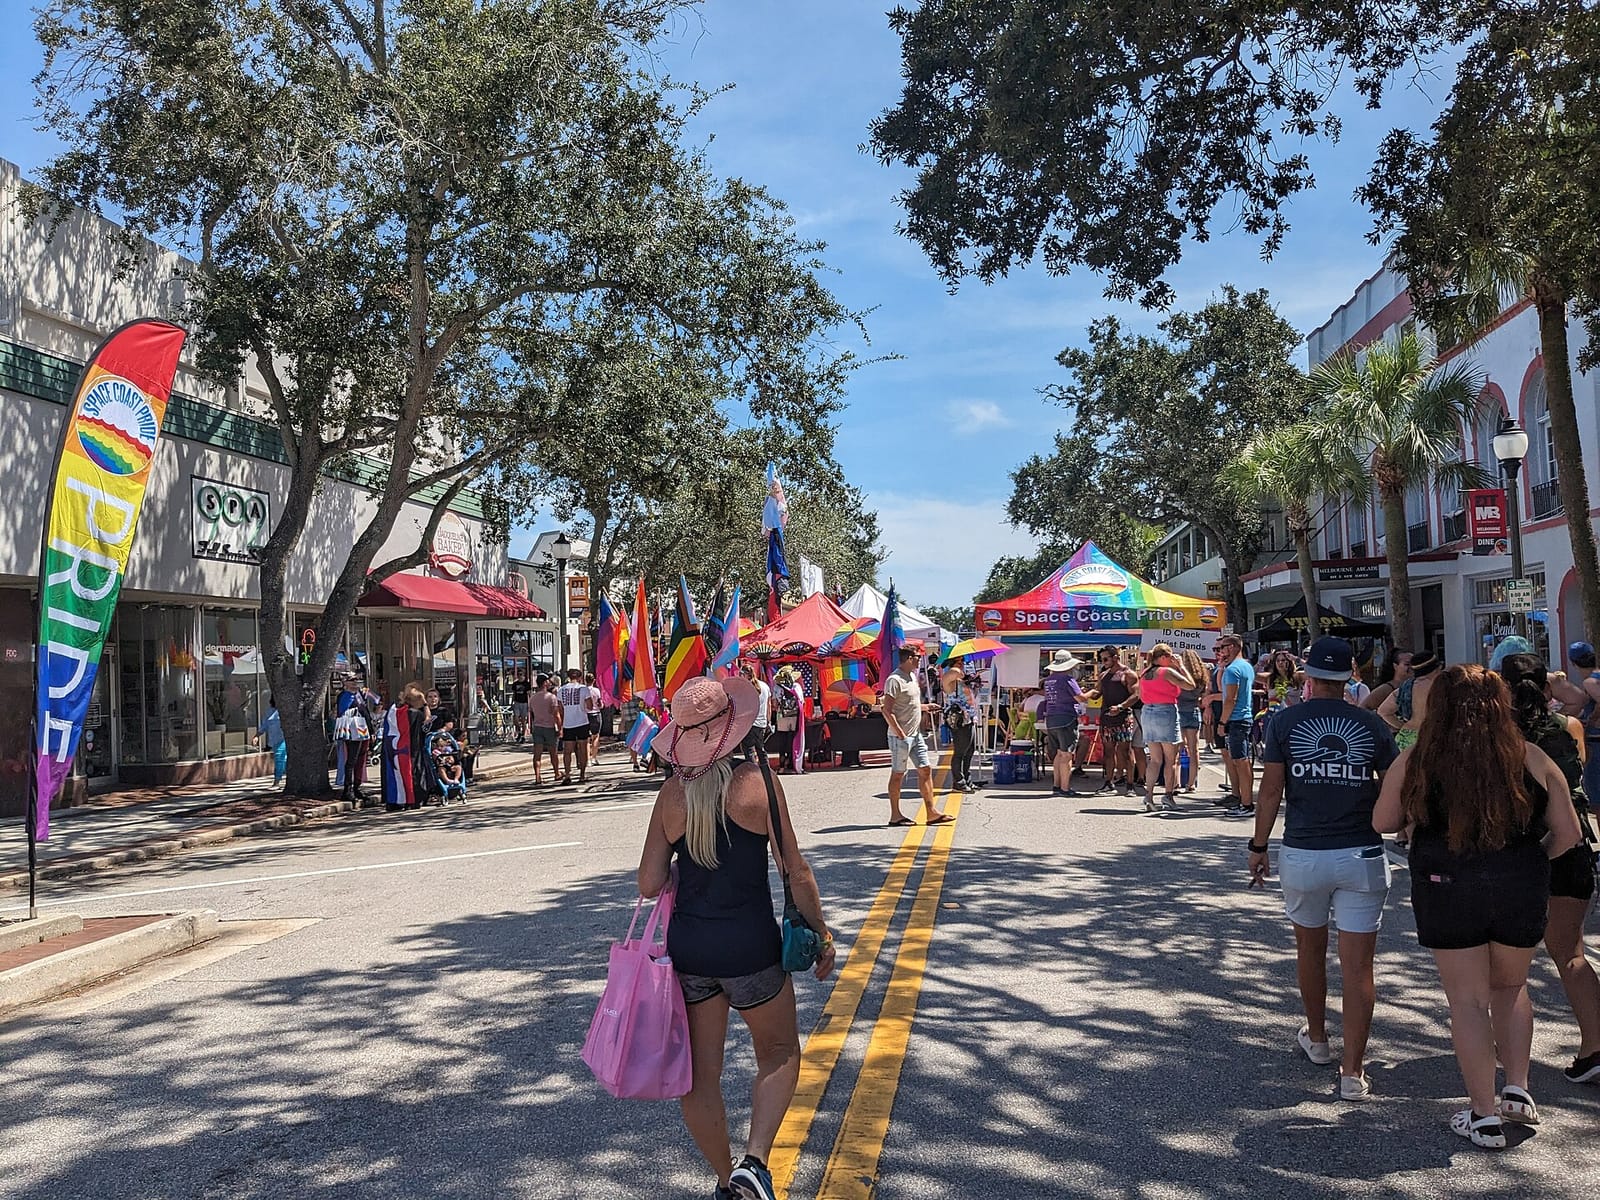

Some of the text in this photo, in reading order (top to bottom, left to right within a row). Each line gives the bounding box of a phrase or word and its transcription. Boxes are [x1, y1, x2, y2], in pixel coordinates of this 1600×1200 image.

[83, 382, 156, 441] SPACE COAST PRIDE
[206, 494, 261, 519] SPA
[42, 477, 136, 763] PRIDE
[1015, 611, 1070, 625] Space
[1077, 609, 1130, 622] Coast
[1137, 608, 1184, 621] Pride
[1174, 629, 1201, 638] Check
[205, 644, 256, 653] dermalogica
[1180, 641, 1206, 651] Bands
[1291, 763, 1370, 780] O'NEILL
